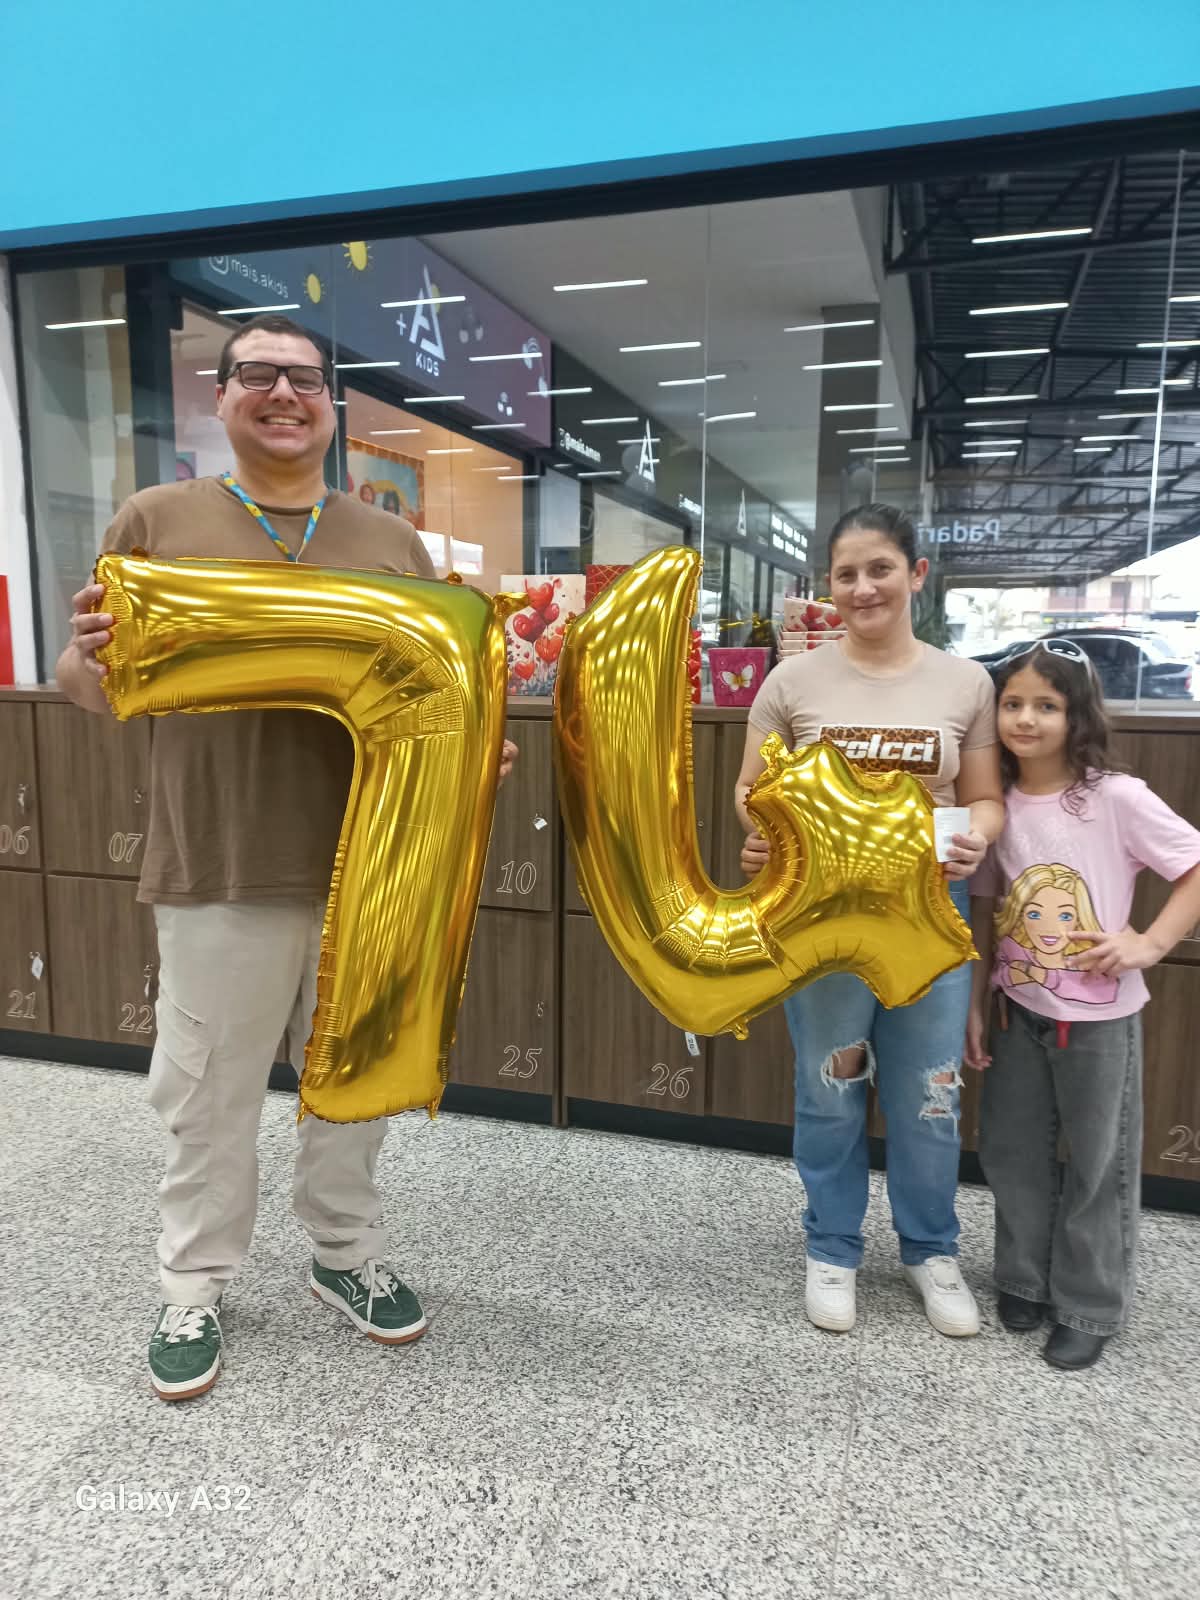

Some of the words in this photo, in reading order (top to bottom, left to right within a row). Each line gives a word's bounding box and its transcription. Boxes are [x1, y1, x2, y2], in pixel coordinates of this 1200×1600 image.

[415, 351, 440, 377] KIDS
[0, 824, 31, 855] 06
[108, 831, 144, 863] 07
[495, 860, 537, 895] 10
[7, 989, 37, 1019] 21
[118, 1002, 154, 1034] 22
[498, 1044, 543, 1079] 25
[646, 1062, 694, 1099] 26
